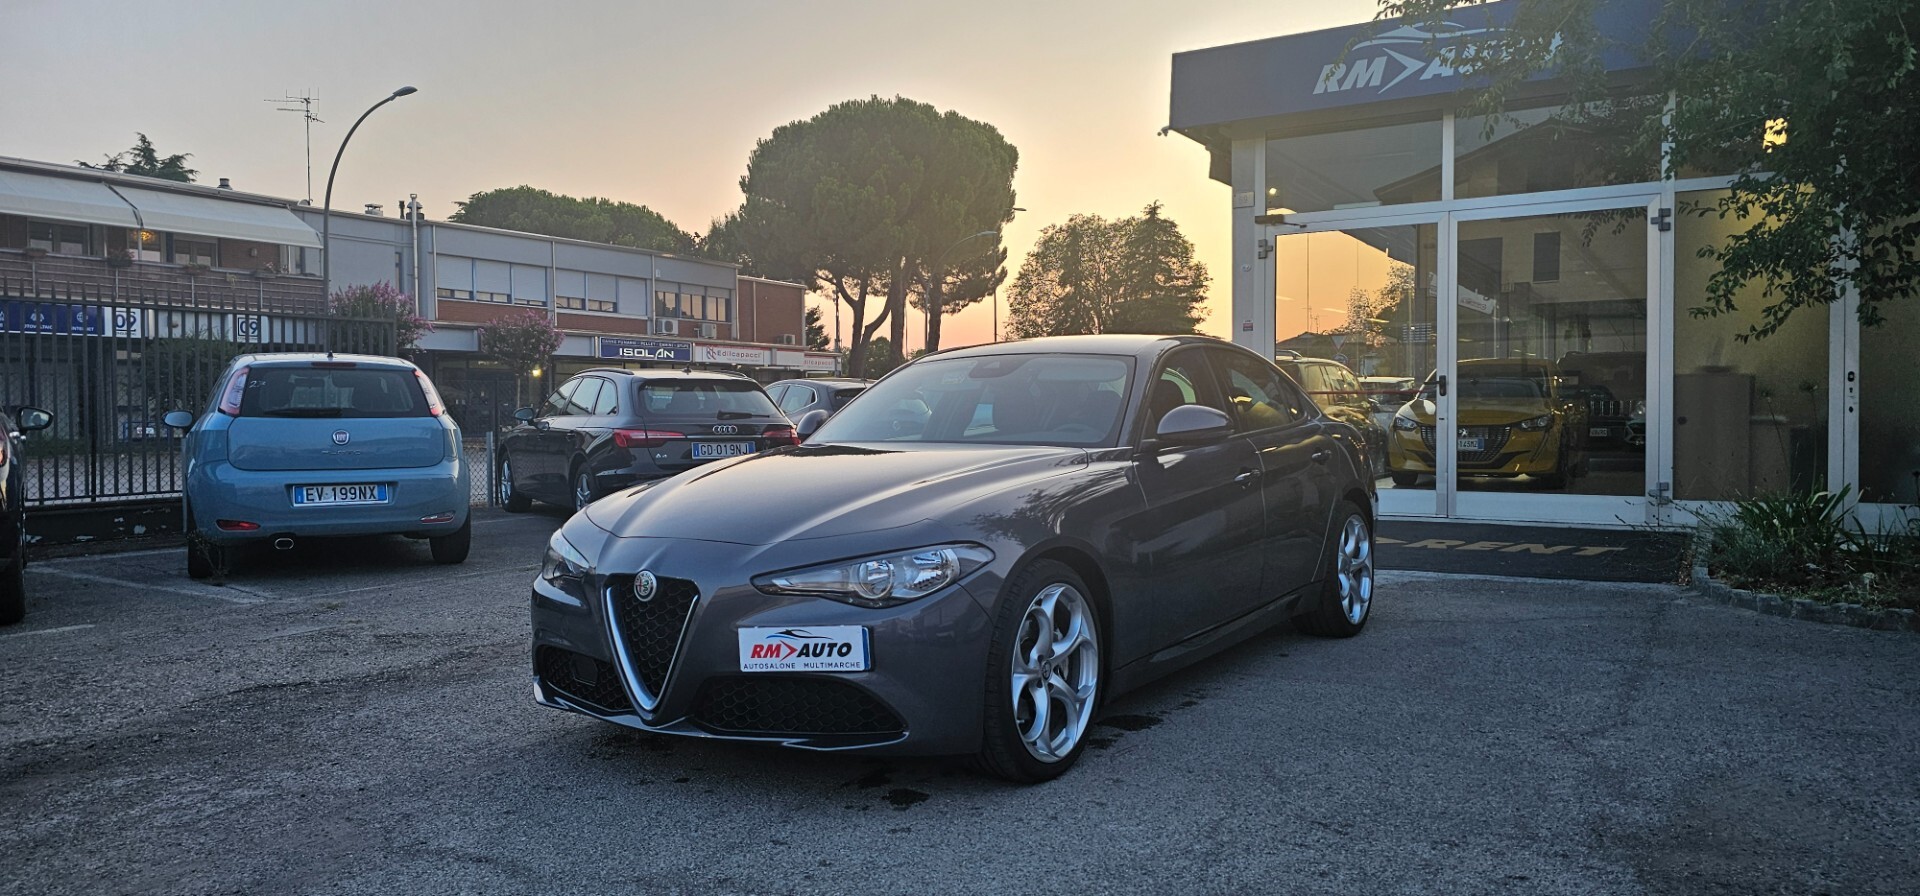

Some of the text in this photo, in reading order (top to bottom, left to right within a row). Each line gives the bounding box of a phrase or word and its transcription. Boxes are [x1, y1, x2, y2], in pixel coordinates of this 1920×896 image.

[619, 347, 674, 360] ISOLAN
[700, 443, 748, 456] GD 019NJ
[305, 486, 376, 501] EV 199NX
[1404, 538, 1627, 556] RENT
